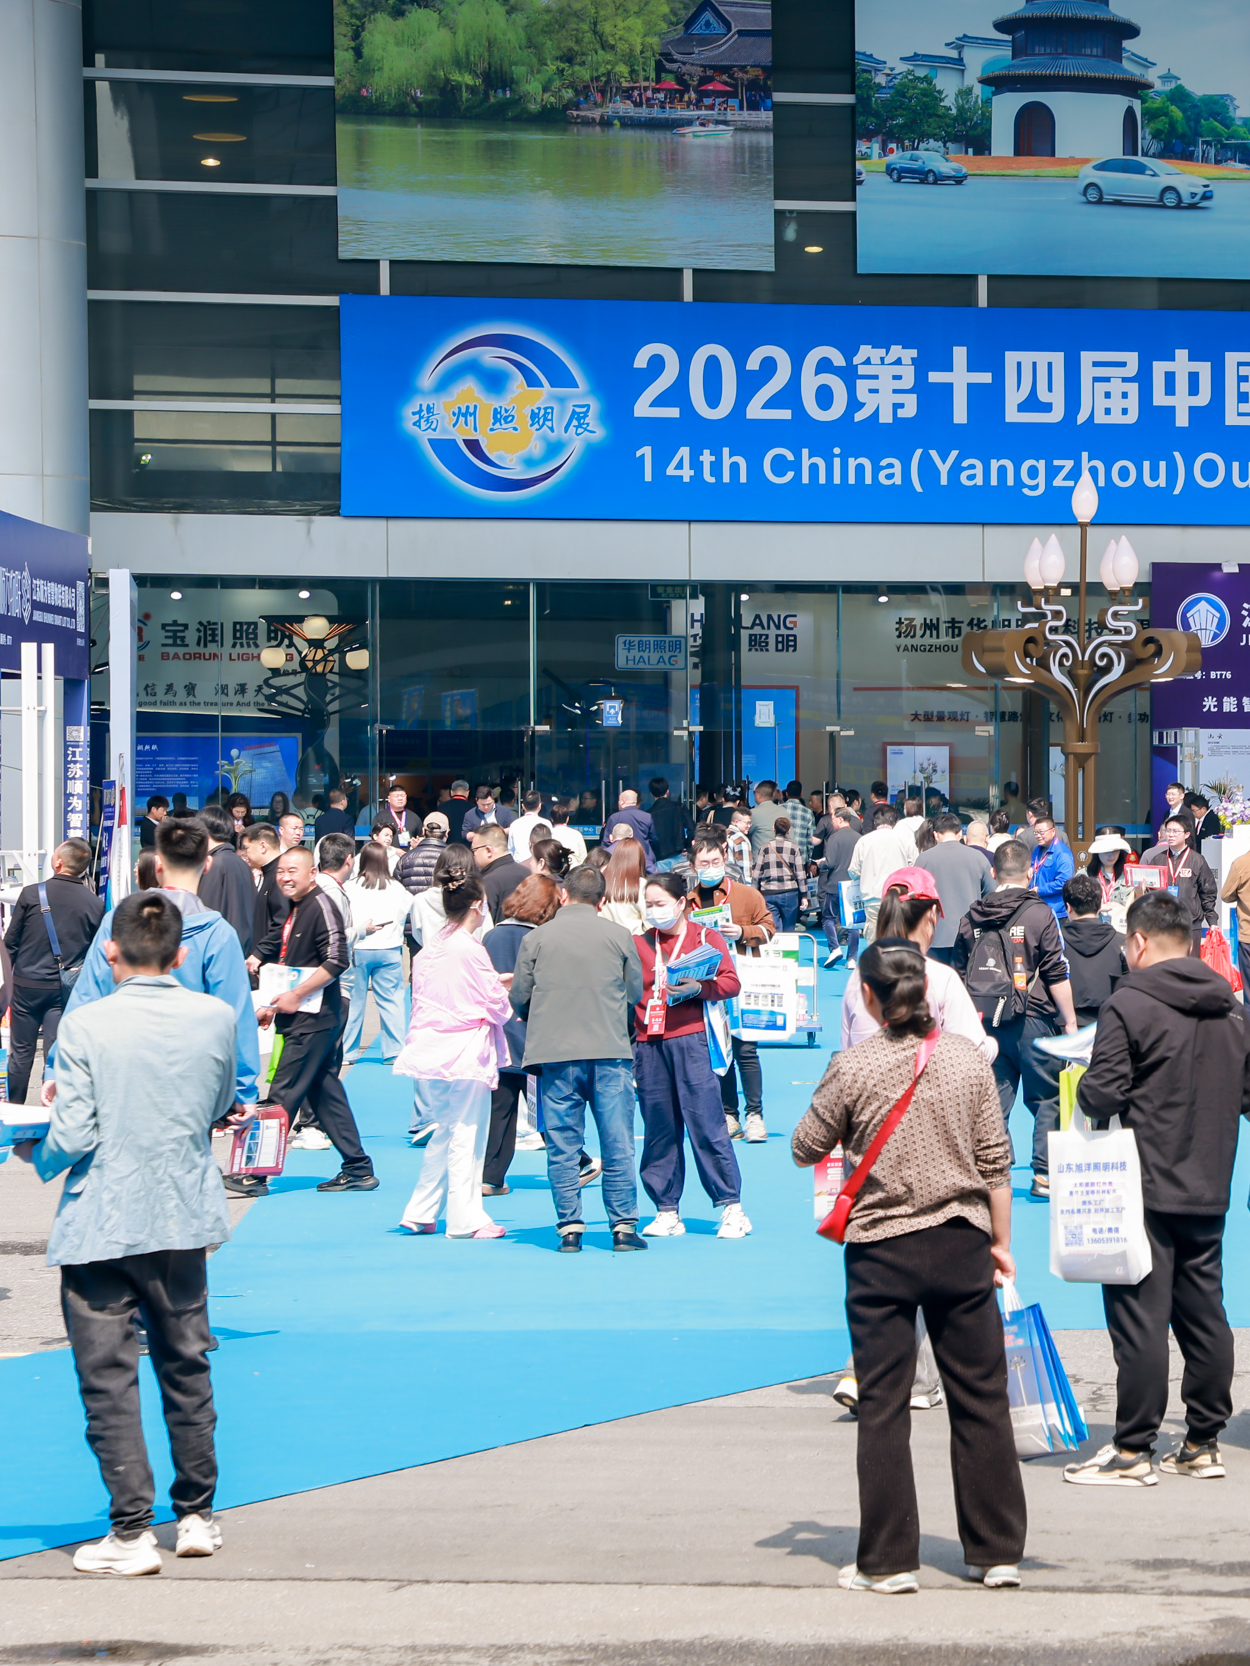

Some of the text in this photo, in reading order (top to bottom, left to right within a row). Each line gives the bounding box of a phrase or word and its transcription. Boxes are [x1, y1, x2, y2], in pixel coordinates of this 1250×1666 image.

[635, 445, 748, 484] 14th
[160, 619, 294, 649] 宝润照明
[621, 639, 682, 655] 华朗照明
[895, 644, 959, 653] YANGZHOU
[160, 651, 294, 662] BAORUN LIGHG
[1210, 670, 1232, 679] BT76
[910, 711, 970, 723] 大型景观灯
[1057, 1160, 1128, 1174] 山东旭洋照明科技
[1091, 1226, 1120, 1235] 电话/微信
